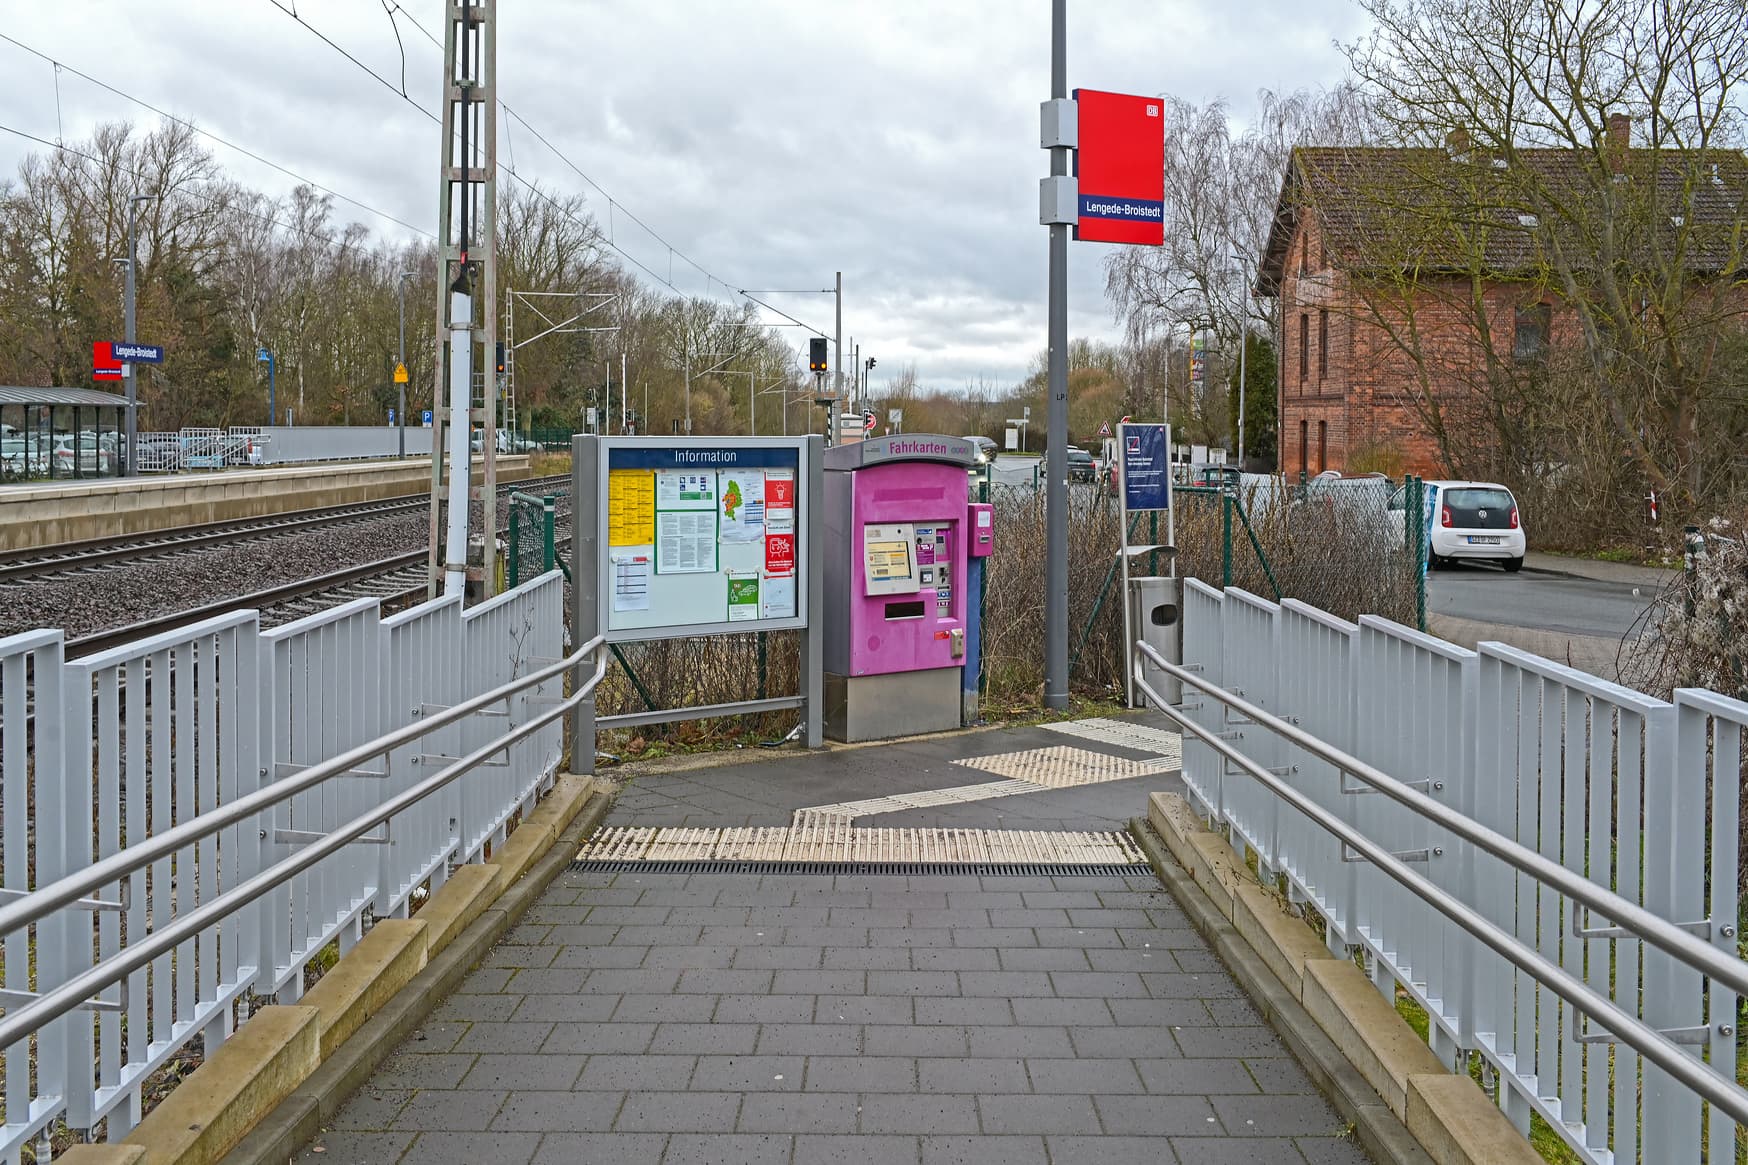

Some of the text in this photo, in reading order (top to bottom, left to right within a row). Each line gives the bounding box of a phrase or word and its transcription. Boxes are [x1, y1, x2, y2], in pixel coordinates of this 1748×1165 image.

[1086, 201, 1161, 218] Lengede-Broistedt
[889, 441, 947, 455] Fahrkarten
[675, 450, 737, 463] Information
